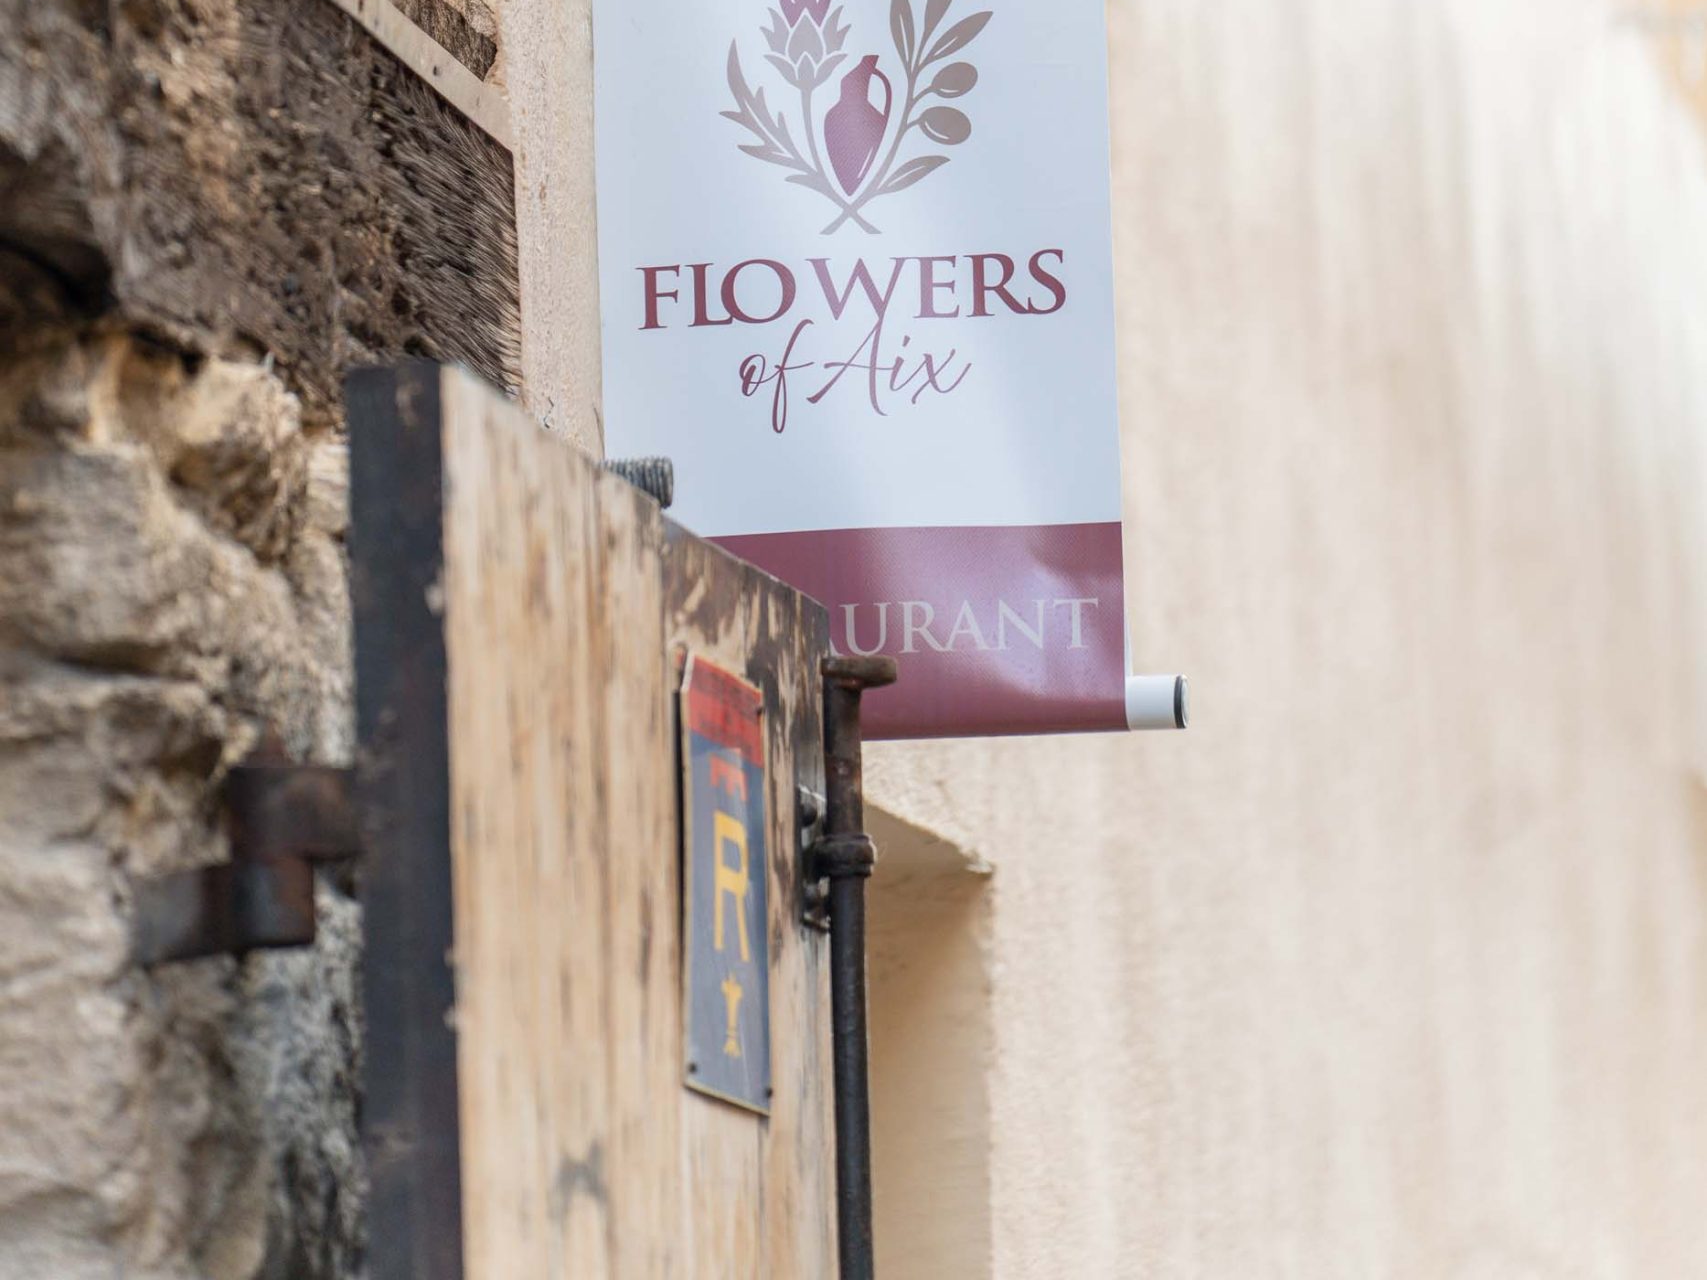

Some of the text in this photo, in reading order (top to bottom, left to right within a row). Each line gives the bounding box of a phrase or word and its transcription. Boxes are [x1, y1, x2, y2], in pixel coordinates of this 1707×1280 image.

[635, 248, 1067, 330] FLOWERS
[739, 318, 972, 433] of Aix
[828, 597, 1098, 657] URANT
